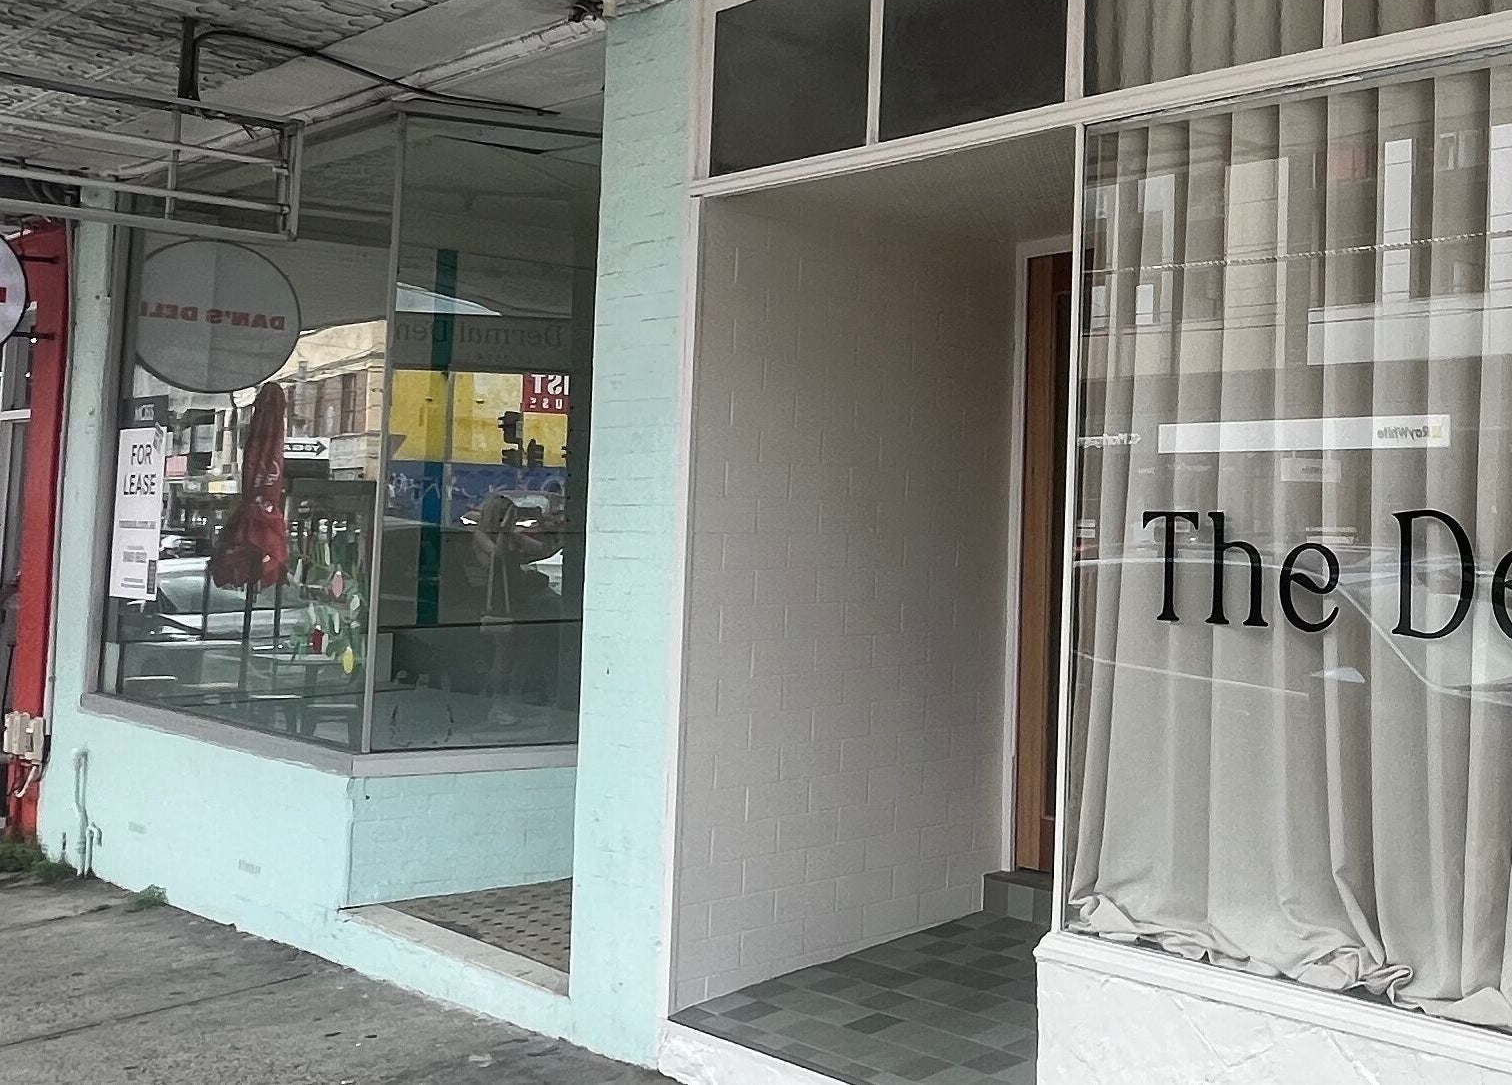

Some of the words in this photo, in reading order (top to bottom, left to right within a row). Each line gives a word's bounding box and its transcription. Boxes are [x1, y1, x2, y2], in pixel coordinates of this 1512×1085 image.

[131, 443, 154, 467] FOR
[123, 473, 157, 496] LEASE
[1142, 509, 1340, 633] The
